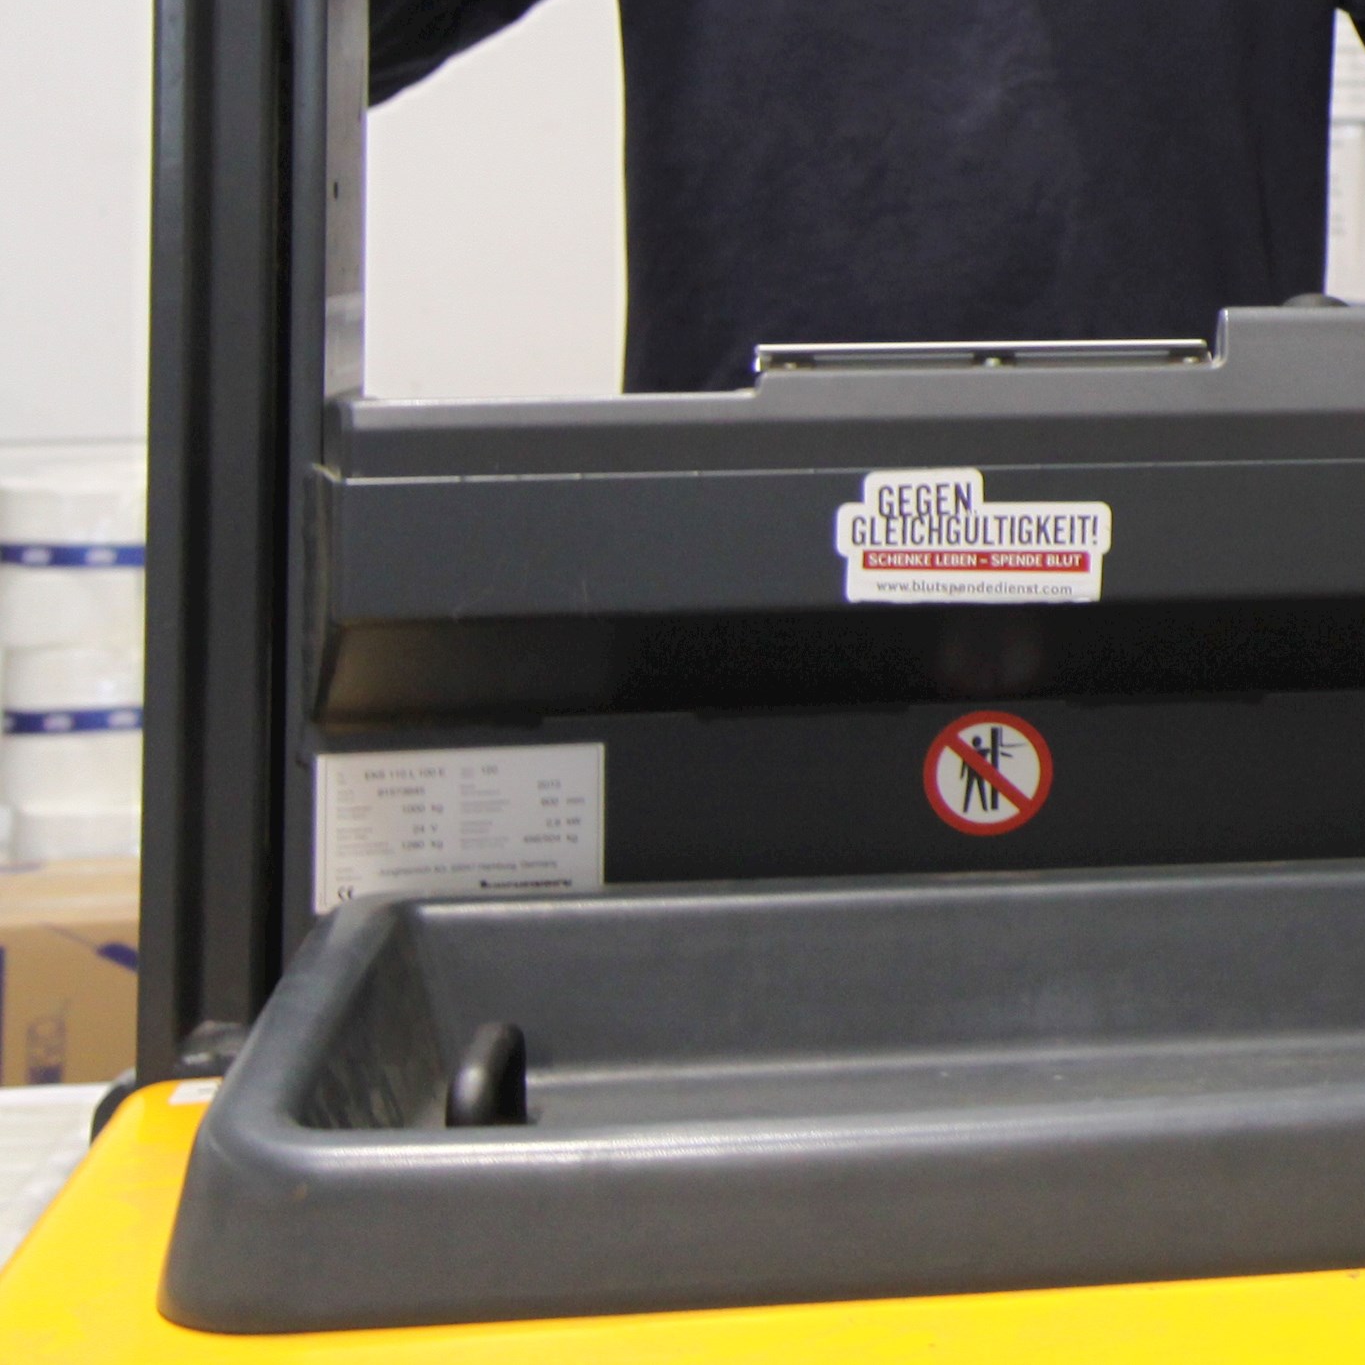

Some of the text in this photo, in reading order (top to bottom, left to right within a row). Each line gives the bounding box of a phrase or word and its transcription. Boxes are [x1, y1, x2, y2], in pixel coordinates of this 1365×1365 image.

[878, 482, 972, 520] GEGEN
[852, 510, 1099, 546] GLEICHGÜLTIGKEIT!
[868, 553, 931, 567] SCHENKE
[935, 553, 977, 567] LEBEN
[991, 553, 1042, 568] SPENDE
[1047, 553, 1082, 568] BLUT
[876, 579, 1073, 596] www.blutspendedienst.com
